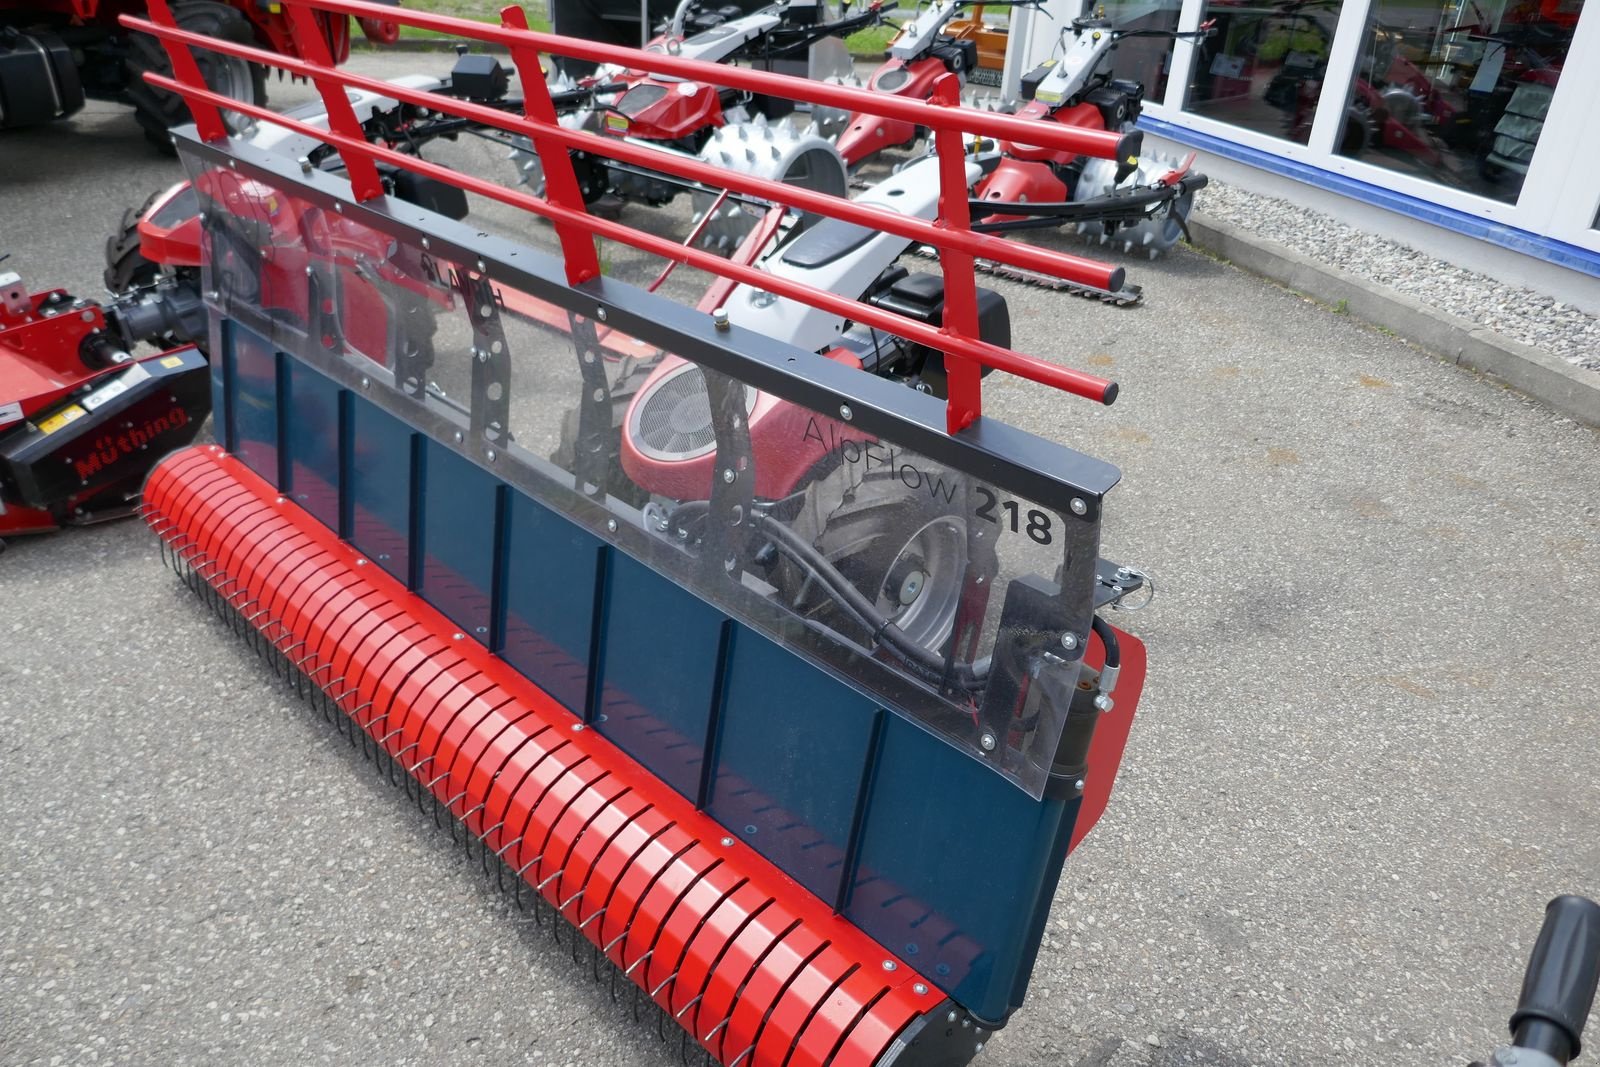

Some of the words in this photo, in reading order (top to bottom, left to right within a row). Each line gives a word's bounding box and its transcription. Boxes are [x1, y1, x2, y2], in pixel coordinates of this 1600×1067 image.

[74, 406, 188, 480] Müthing
[802, 416, 957, 505] AlpFlow
[975, 486, 1052, 546] 218
